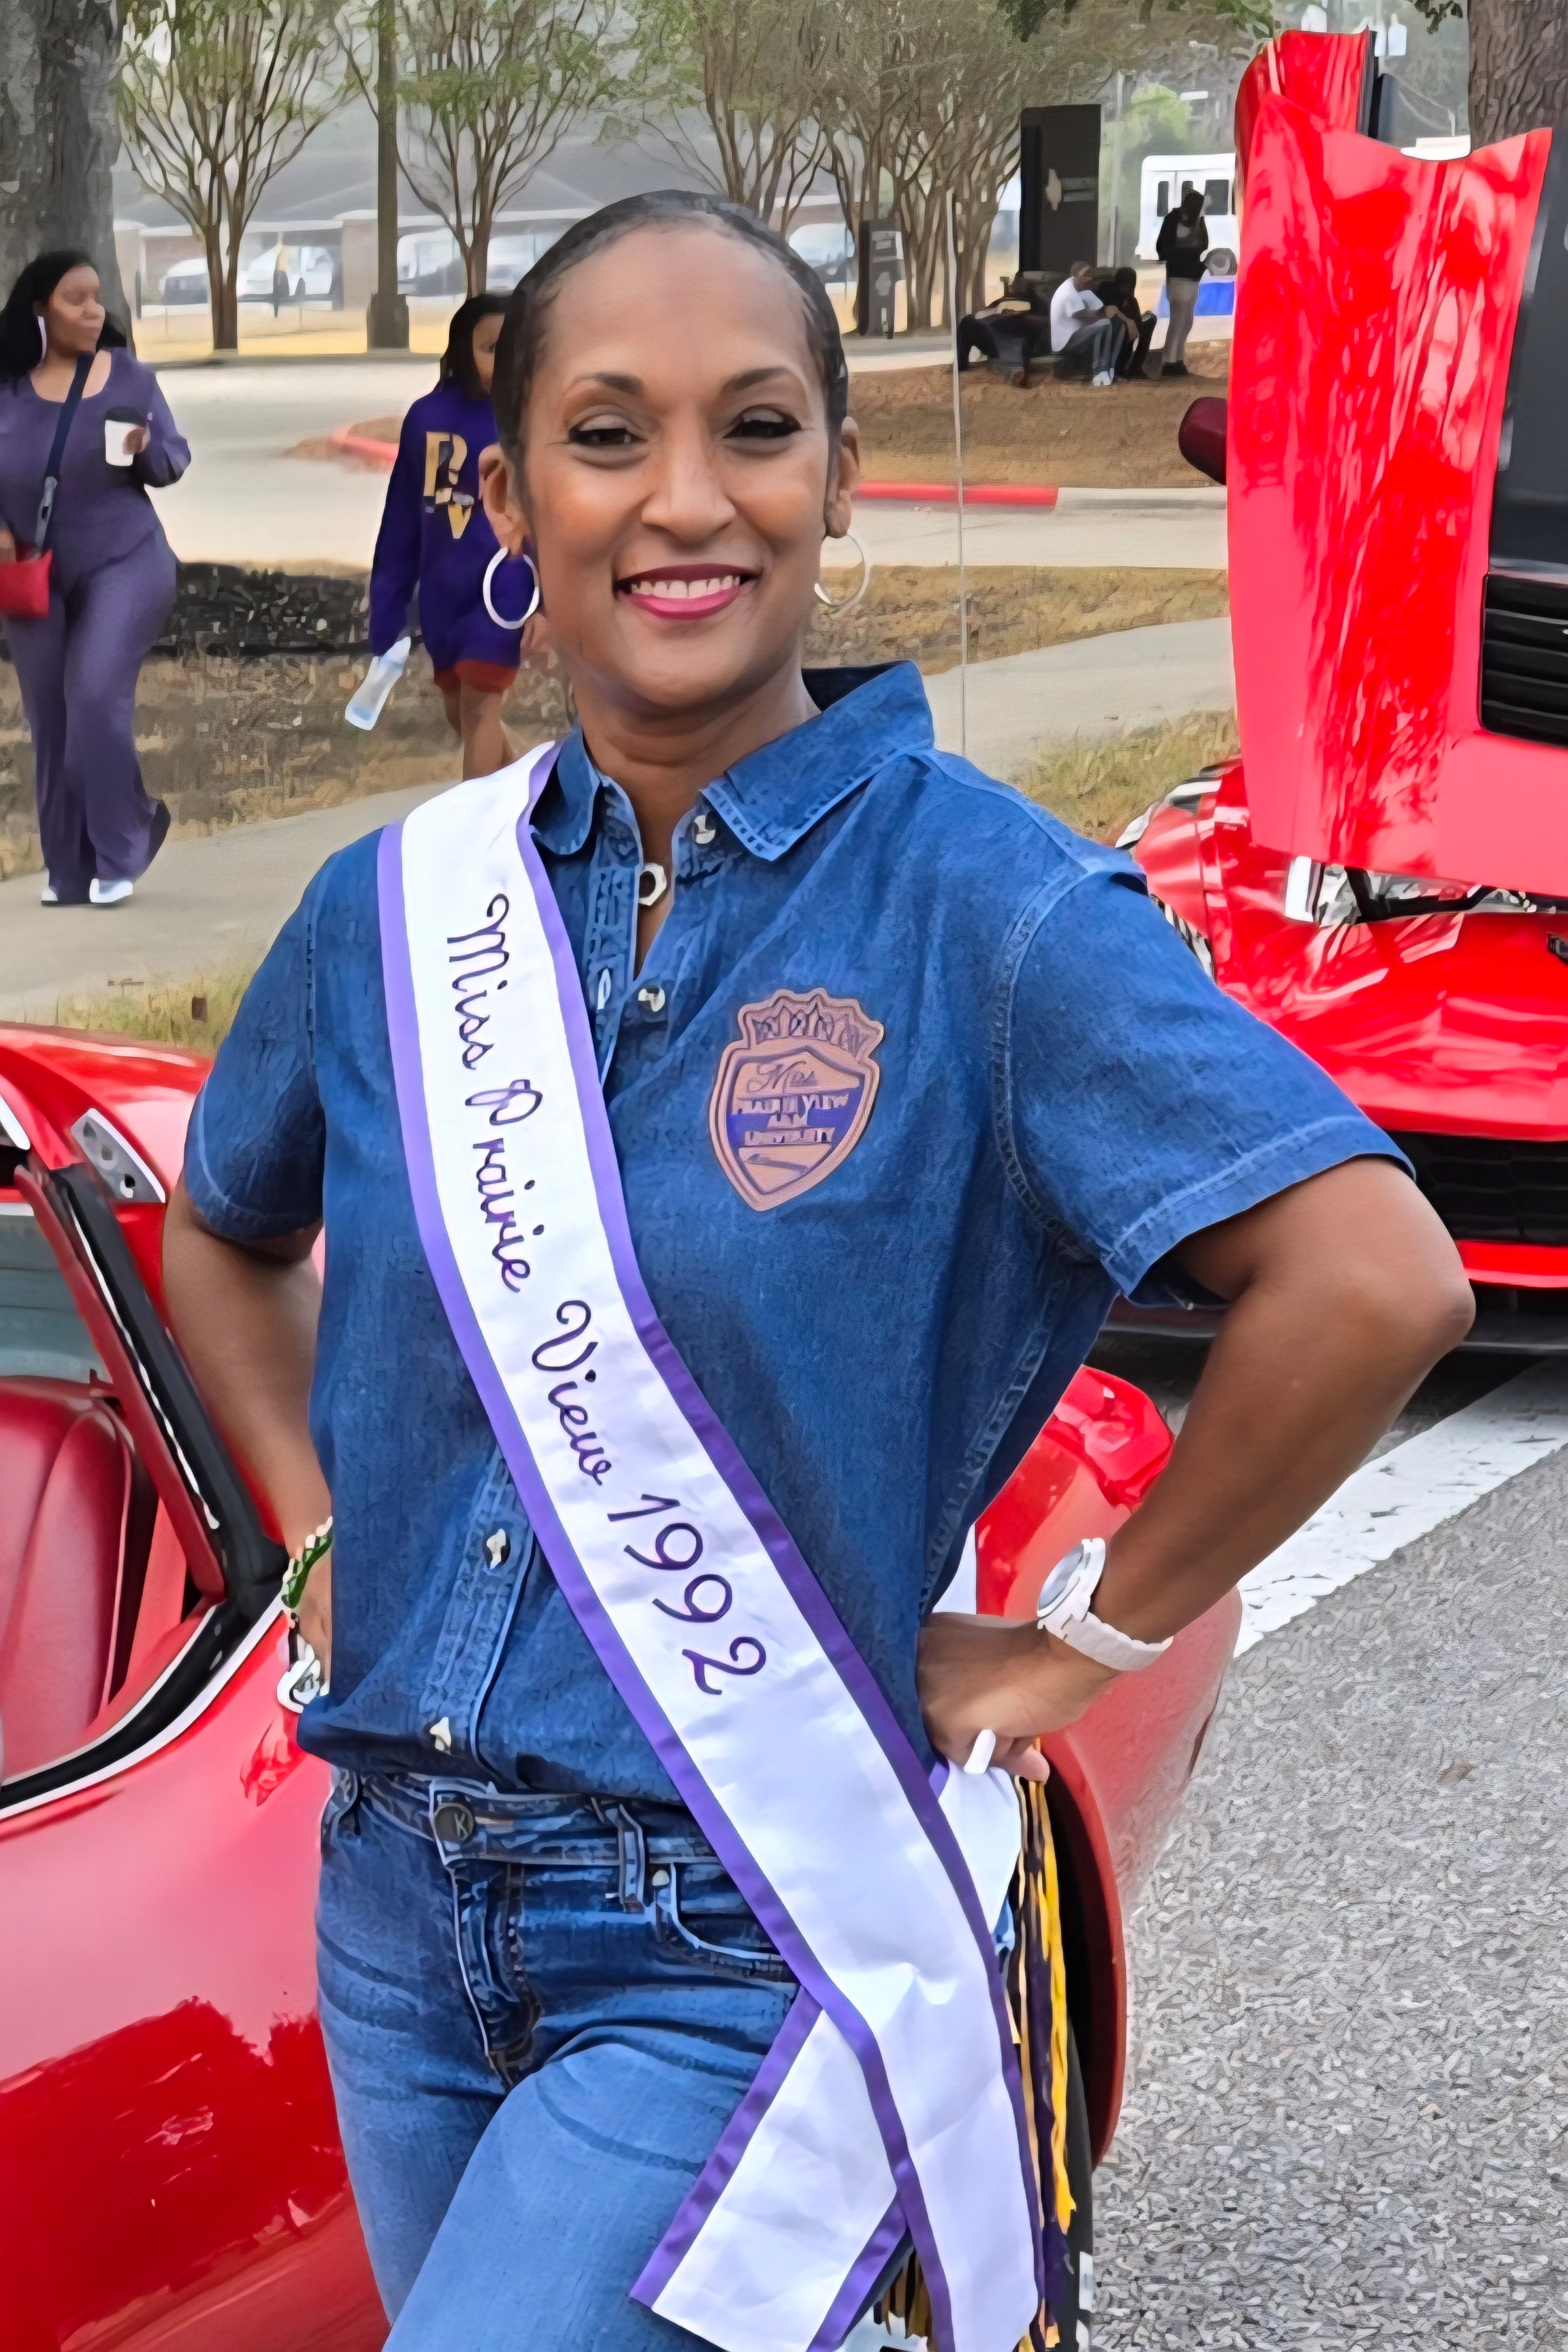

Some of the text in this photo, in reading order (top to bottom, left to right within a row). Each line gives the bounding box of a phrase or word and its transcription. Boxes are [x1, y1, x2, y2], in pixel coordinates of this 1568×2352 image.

[447, 893, 767, 1695] Miss Prairie View 1992
